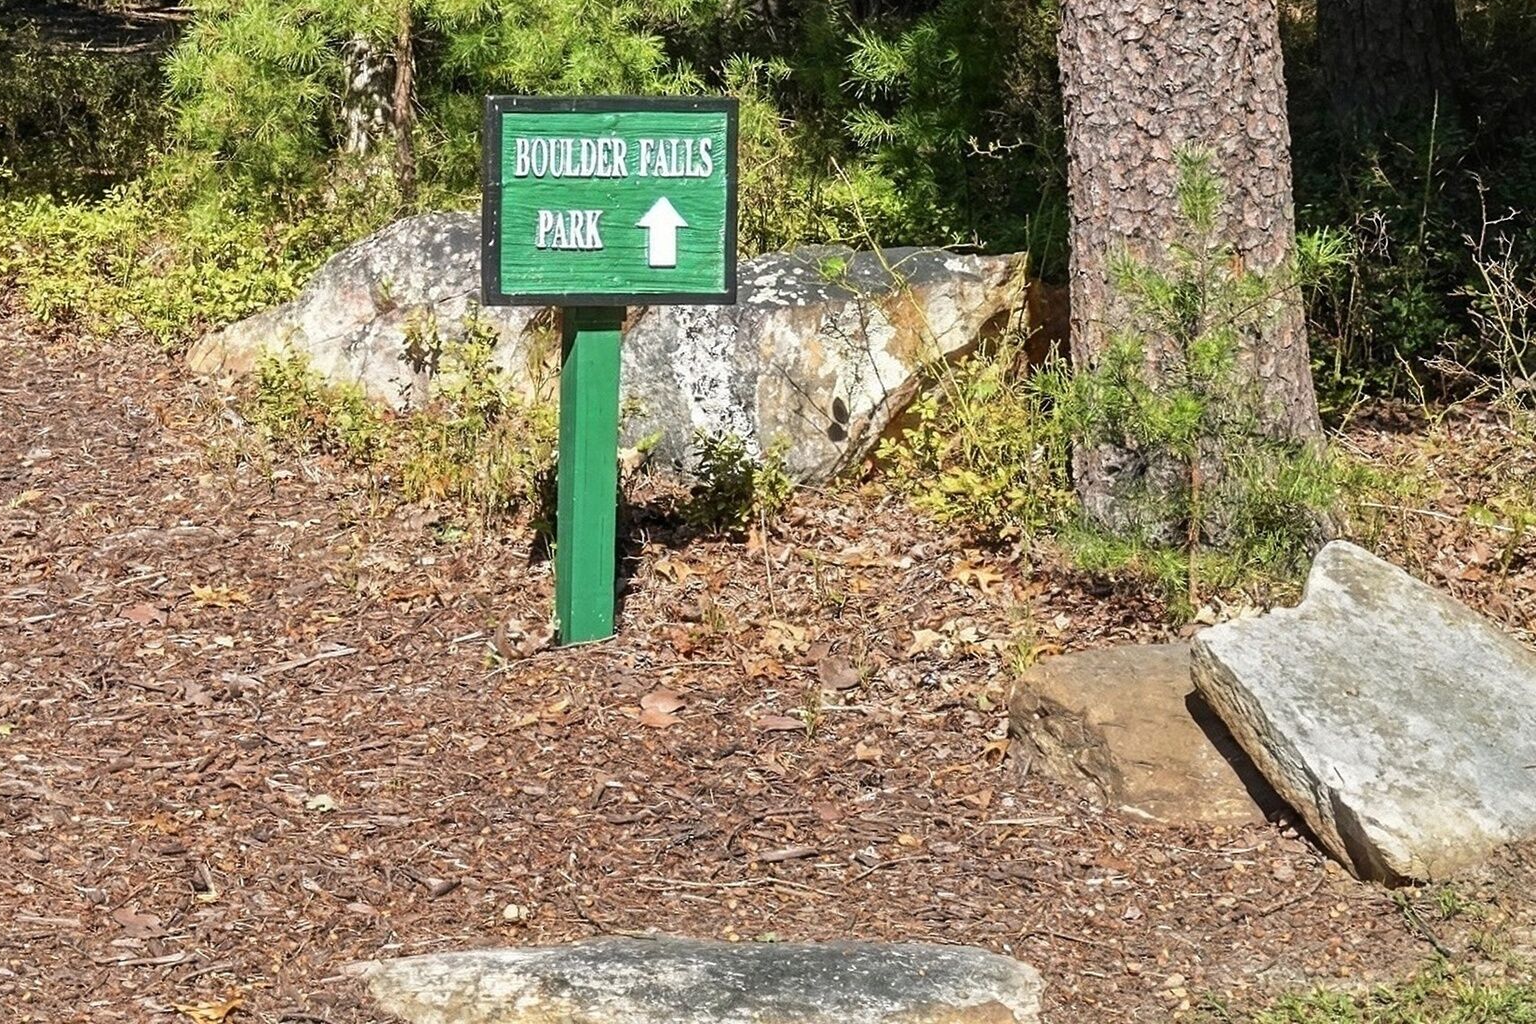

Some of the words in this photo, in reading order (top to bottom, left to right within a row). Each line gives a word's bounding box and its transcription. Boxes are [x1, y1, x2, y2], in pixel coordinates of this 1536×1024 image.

[515, 137, 628, 177] BOULDER
[639, 137, 713, 177] FALLS
[536, 209, 604, 249] PARK
